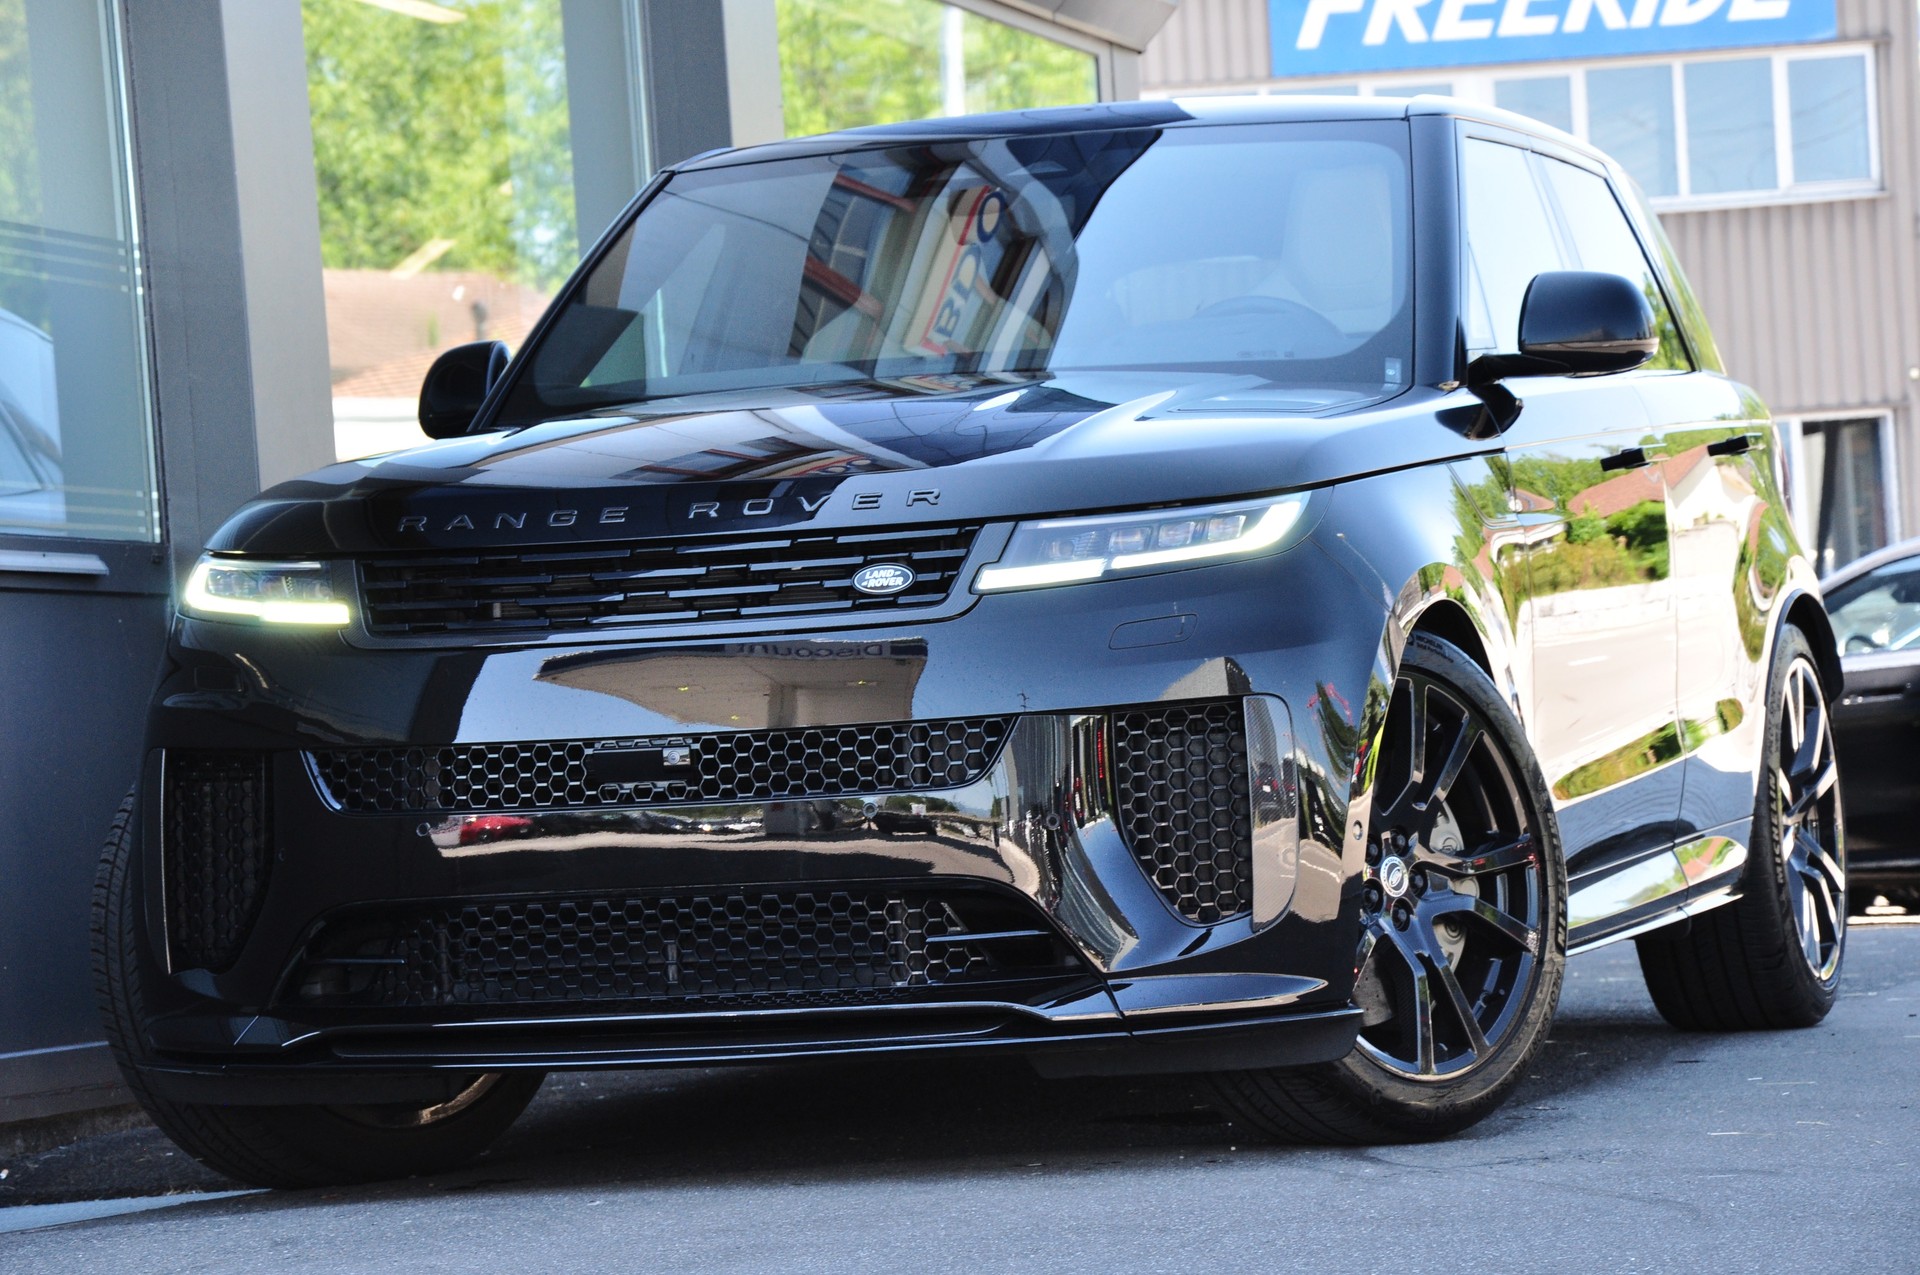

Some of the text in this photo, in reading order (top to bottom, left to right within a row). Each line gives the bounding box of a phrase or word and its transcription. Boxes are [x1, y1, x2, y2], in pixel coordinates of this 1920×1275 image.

[398, 488, 942, 532] RANGE ROVER
[864, 568, 895, 580] LAND
[867, 576, 904, 588] ROVER
[1768, 771, 1784, 884] MICHELIN
